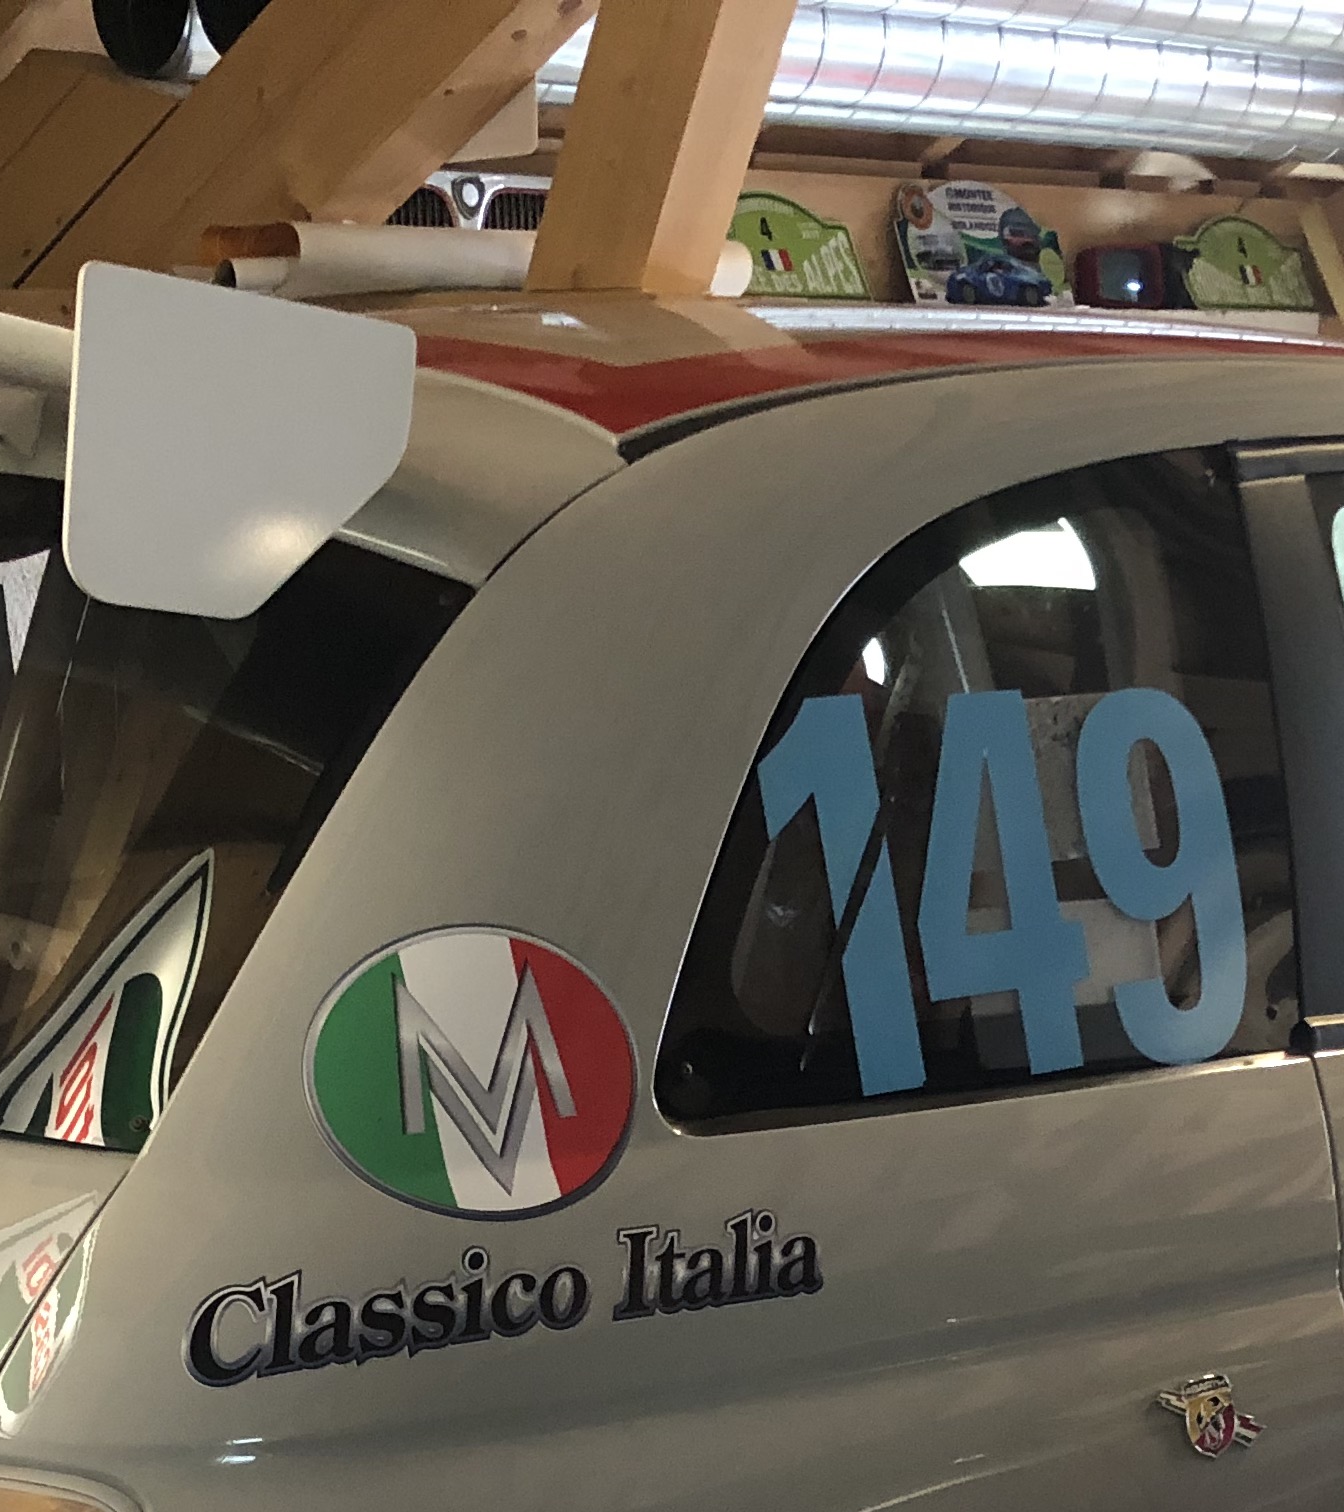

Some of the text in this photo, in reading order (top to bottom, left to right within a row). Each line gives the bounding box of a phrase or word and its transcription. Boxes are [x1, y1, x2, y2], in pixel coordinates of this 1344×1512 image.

[760, 217, 773, 241] 4
[757, 687, 1247, 1097] 149
[181, 1245, 591, 1388] Classico
[612, 1209, 824, 1322] Italia
